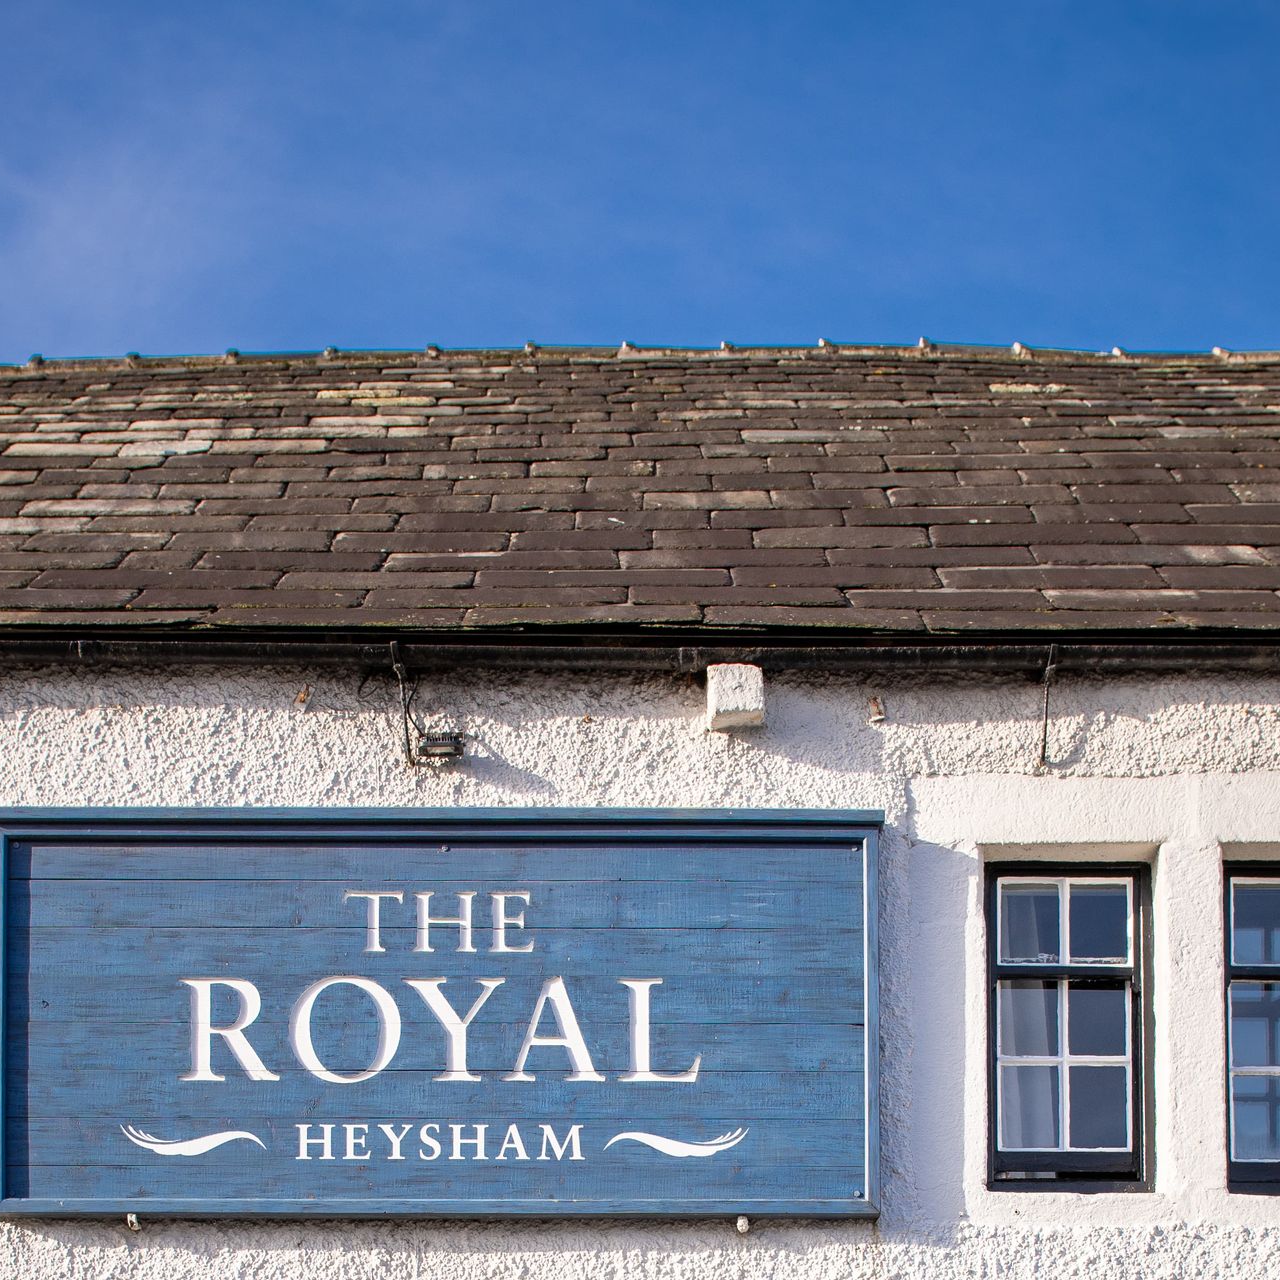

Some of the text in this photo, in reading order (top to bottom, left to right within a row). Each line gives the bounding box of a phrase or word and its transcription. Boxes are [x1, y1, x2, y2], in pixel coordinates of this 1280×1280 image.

[343, 889, 535, 953] THE
[177, 974, 703, 1084] ROYAL
[294, 1123, 587, 1162] HEYSHAM
